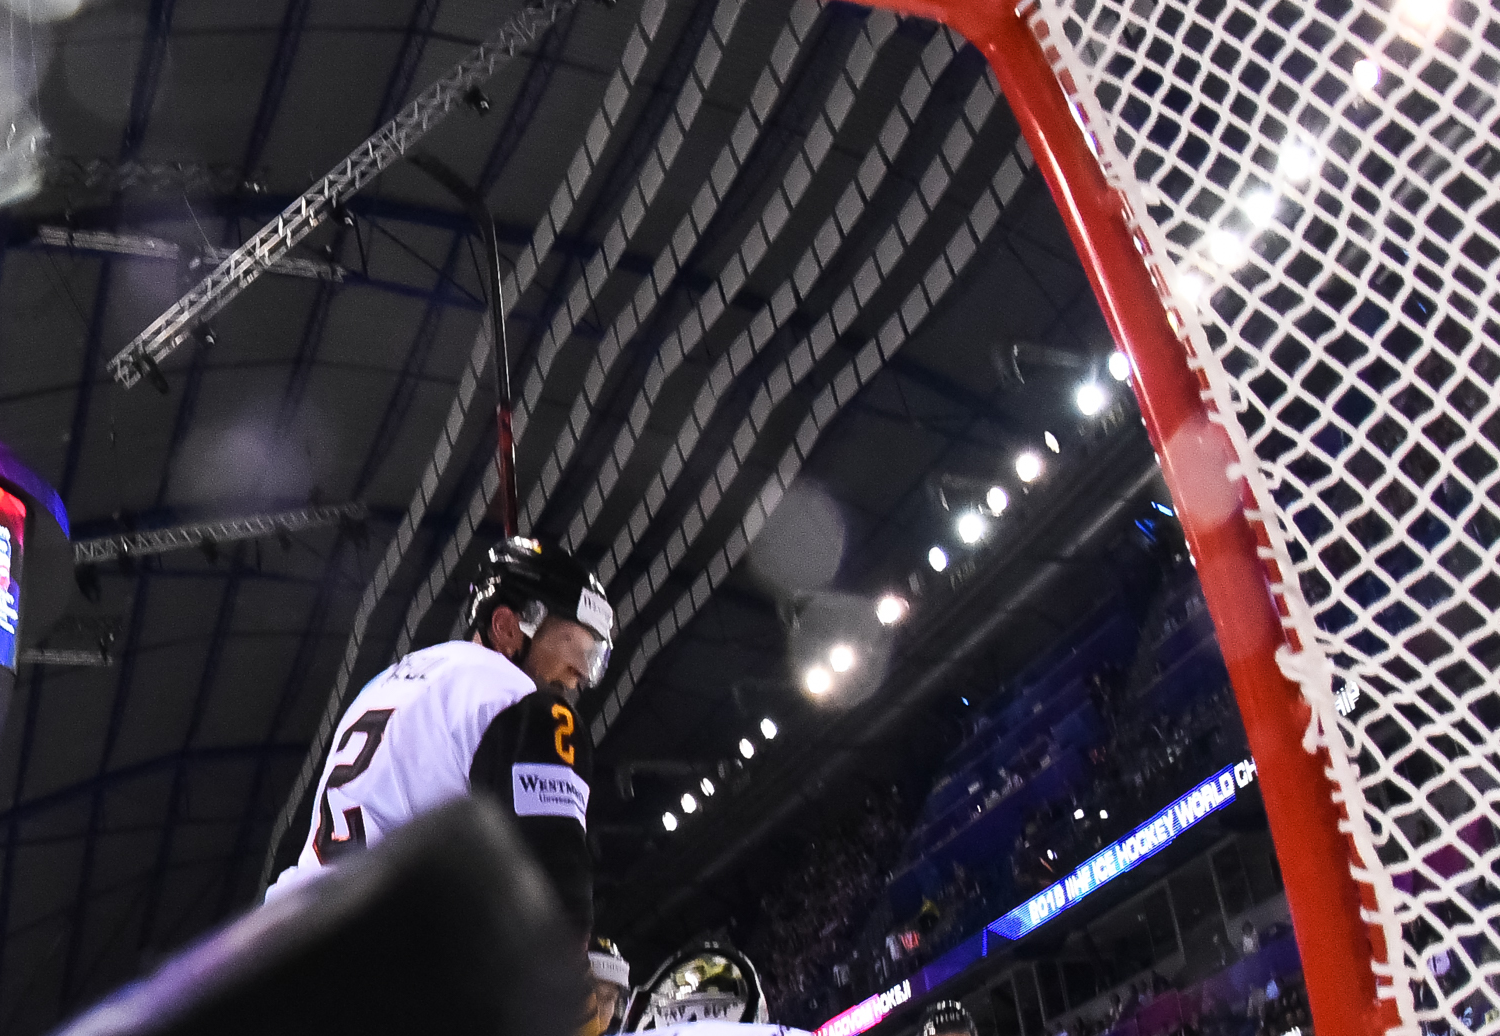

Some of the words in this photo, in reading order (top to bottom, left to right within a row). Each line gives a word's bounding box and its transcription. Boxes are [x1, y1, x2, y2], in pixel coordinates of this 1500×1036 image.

[551, 703, 575, 766] 2
[1091, 853, 1119, 885] ICE
[1115, 809, 1176, 868] HOCKEY
[1174, 771, 1235, 827] WORLD
